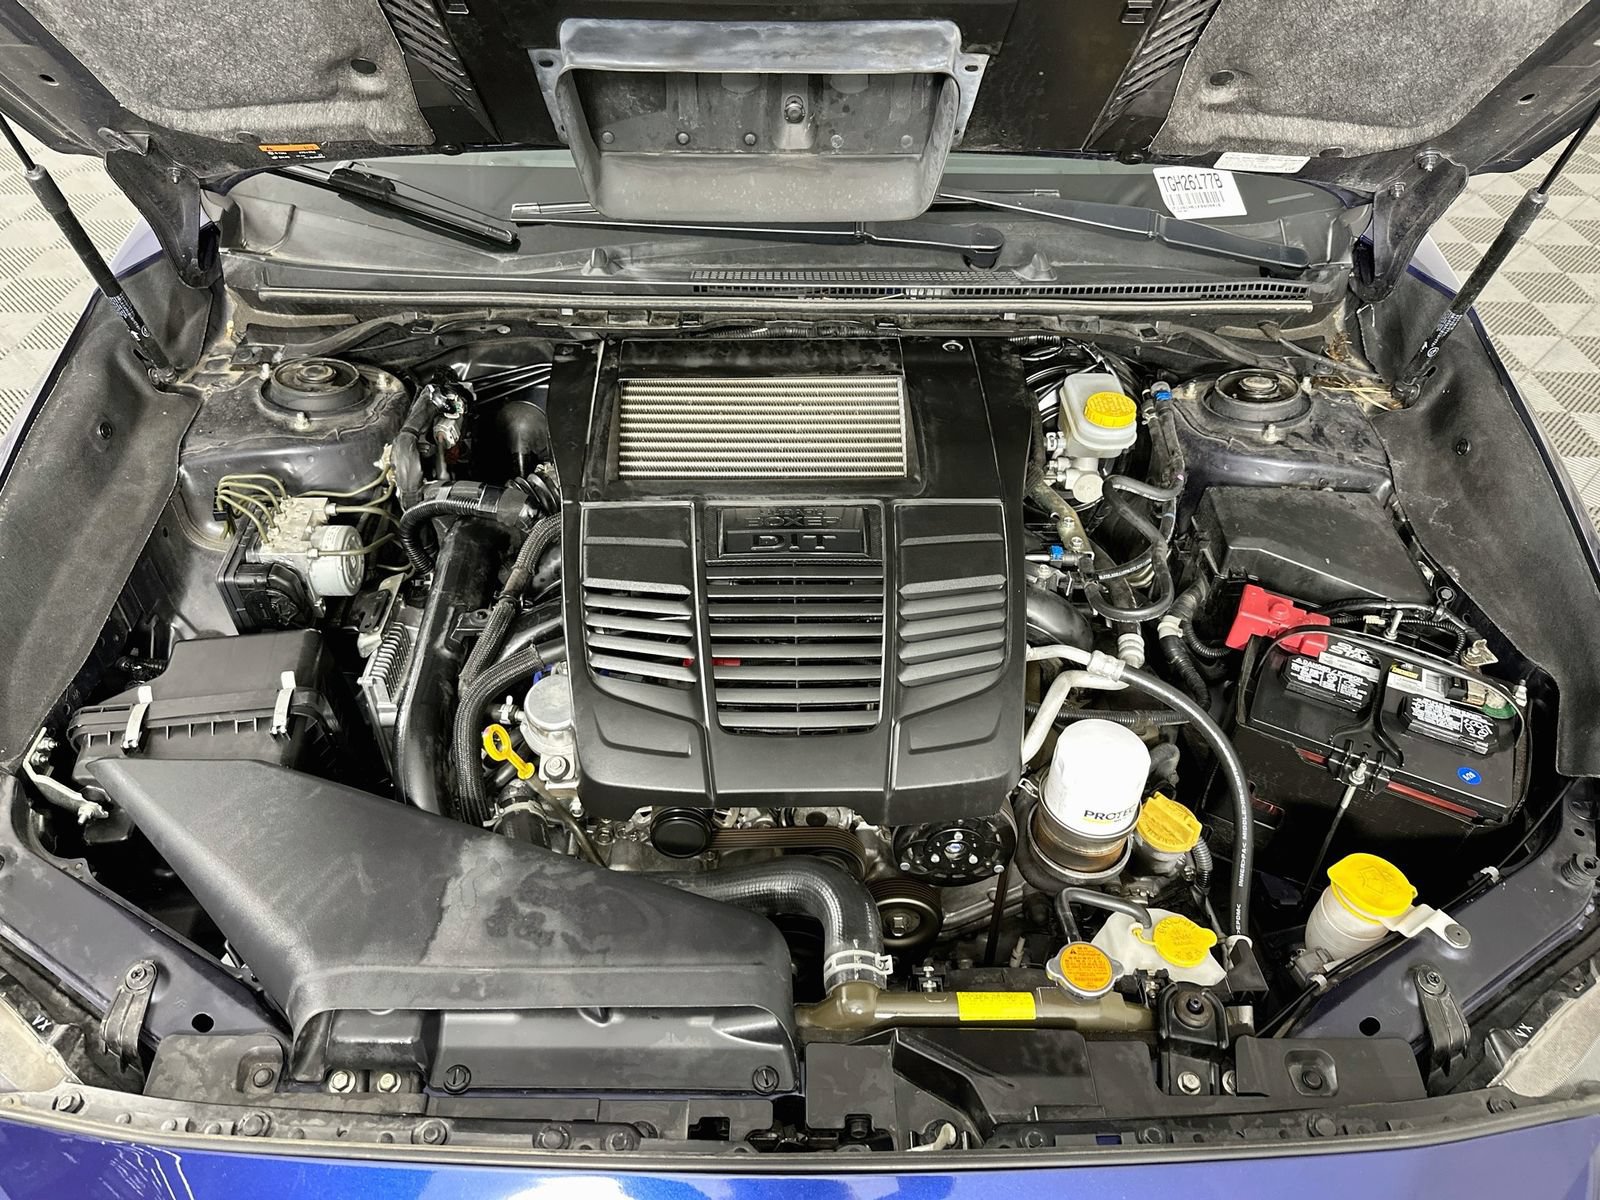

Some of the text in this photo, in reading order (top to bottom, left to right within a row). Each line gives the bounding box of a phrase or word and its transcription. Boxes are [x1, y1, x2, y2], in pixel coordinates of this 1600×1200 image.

[1160, 172, 1223, 192] TGH26177B
[751, 534, 837, 551] DIT
[32, 1014, 52, 1031] VX
